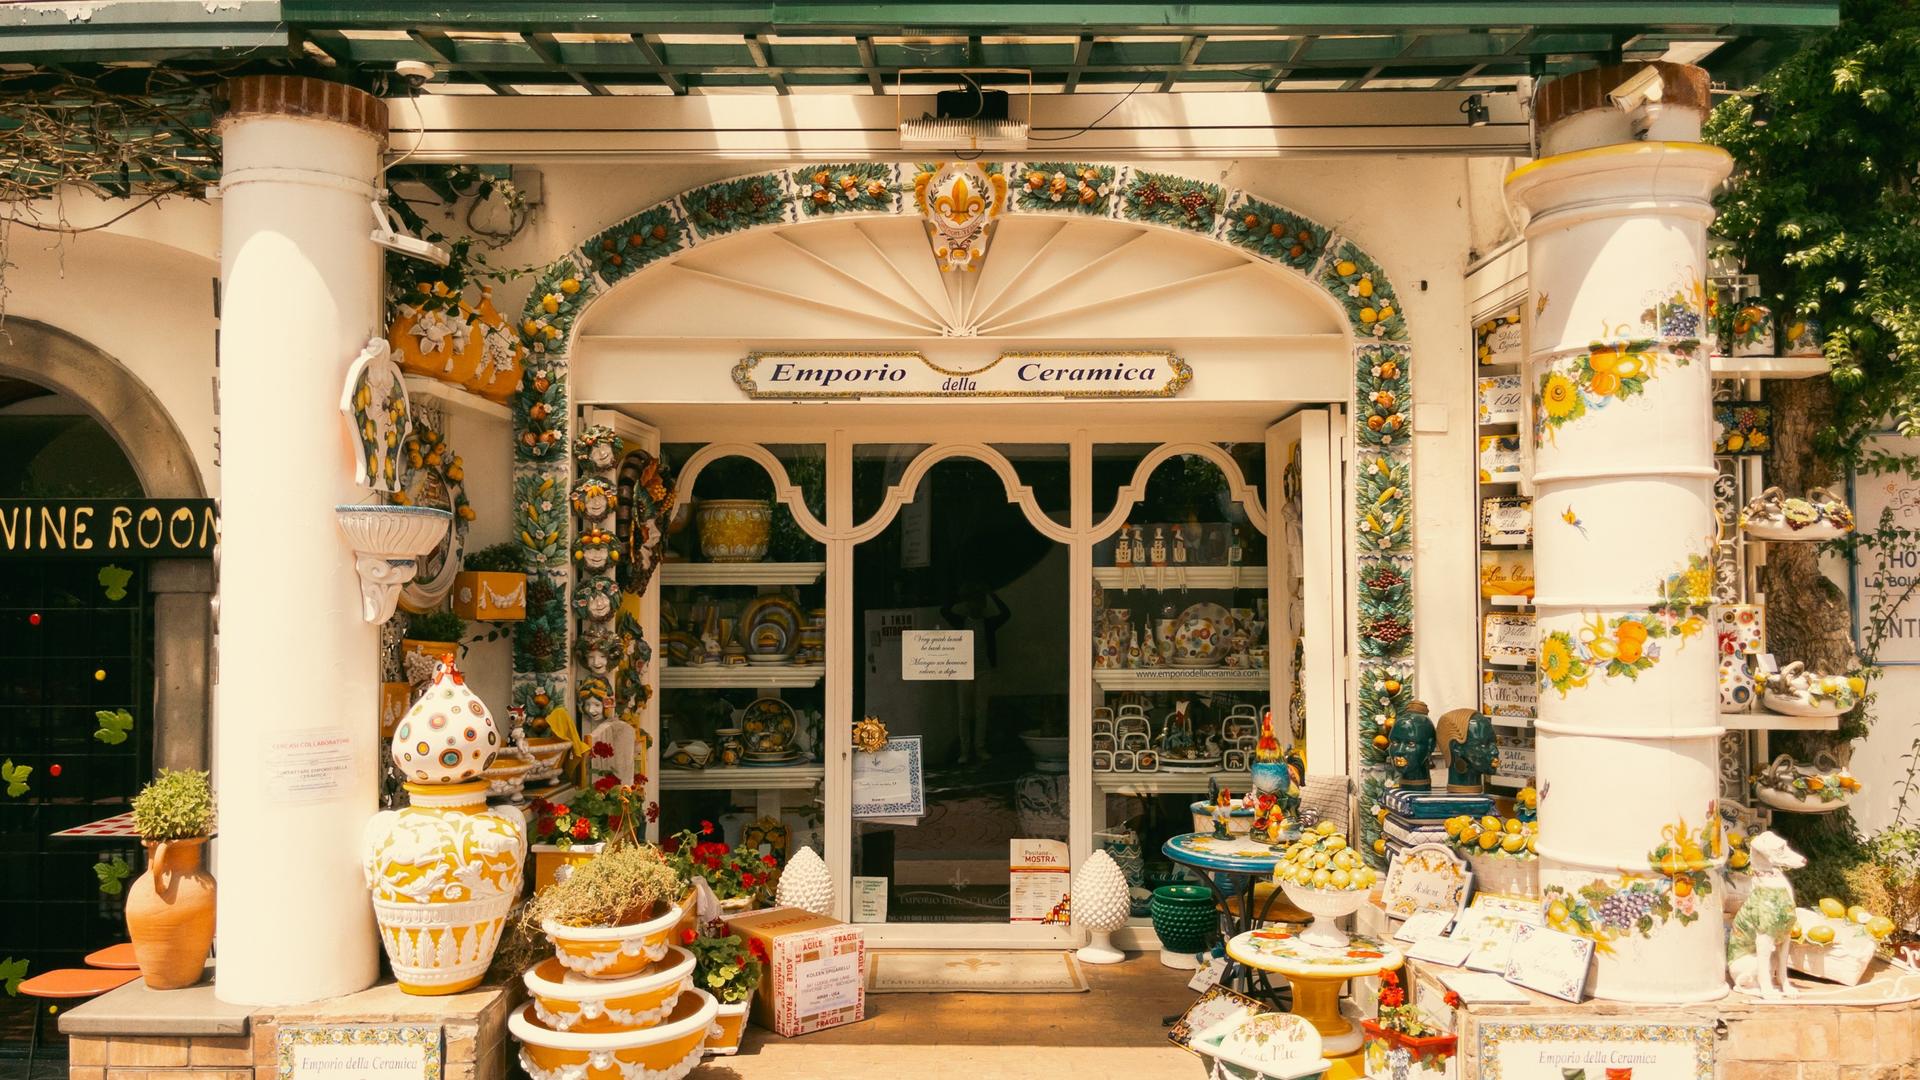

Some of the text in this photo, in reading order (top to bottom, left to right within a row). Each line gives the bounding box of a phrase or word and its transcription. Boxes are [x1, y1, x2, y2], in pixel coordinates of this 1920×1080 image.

[769, 362, 1156, 392] Emporio della Ceramica
[1136, 669, 1260, 679] www.emporiodellaceramica.com
[815, 1015, 844, 1028] FRAGILE
[302, 1056, 417, 1073] Emporio della Ceramica
[1539, 1050, 1657, 1067] Emporio della Ceramica
